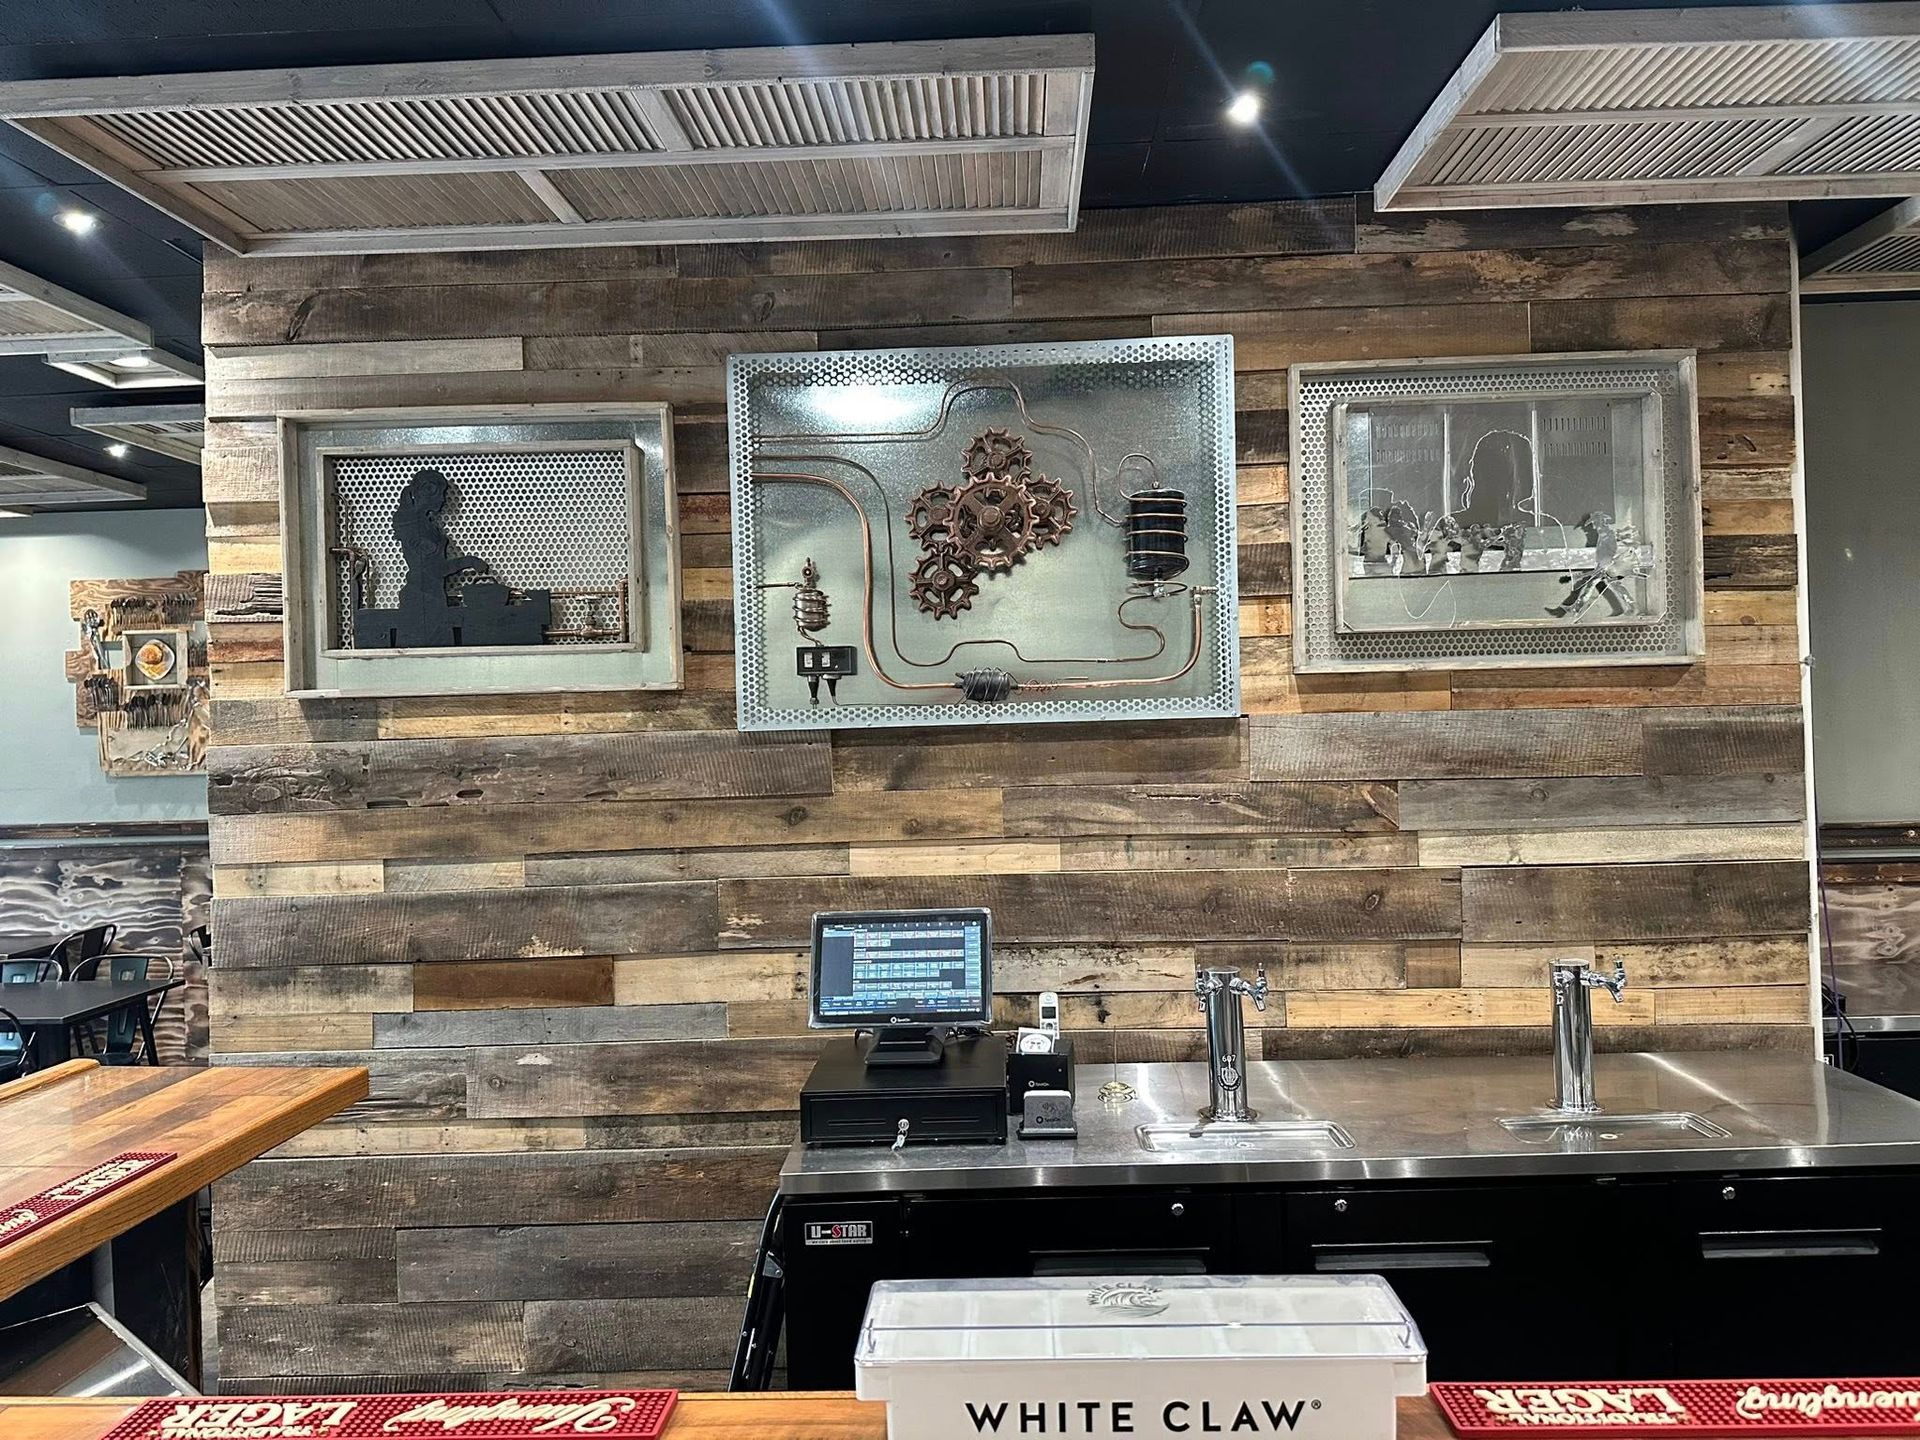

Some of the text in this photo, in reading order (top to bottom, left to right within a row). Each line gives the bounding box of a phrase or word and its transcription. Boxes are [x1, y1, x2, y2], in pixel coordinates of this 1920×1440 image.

[810, 1224, 867, 1239] U-STAR
[1473, 1388, 1686, 1413] LAGER
[160, 1402, 358, 1428] LAGER
[965, 1401, 1135, 1433] WHITE
[1509, 1412, 1677, 1425] TRADITIONAL
